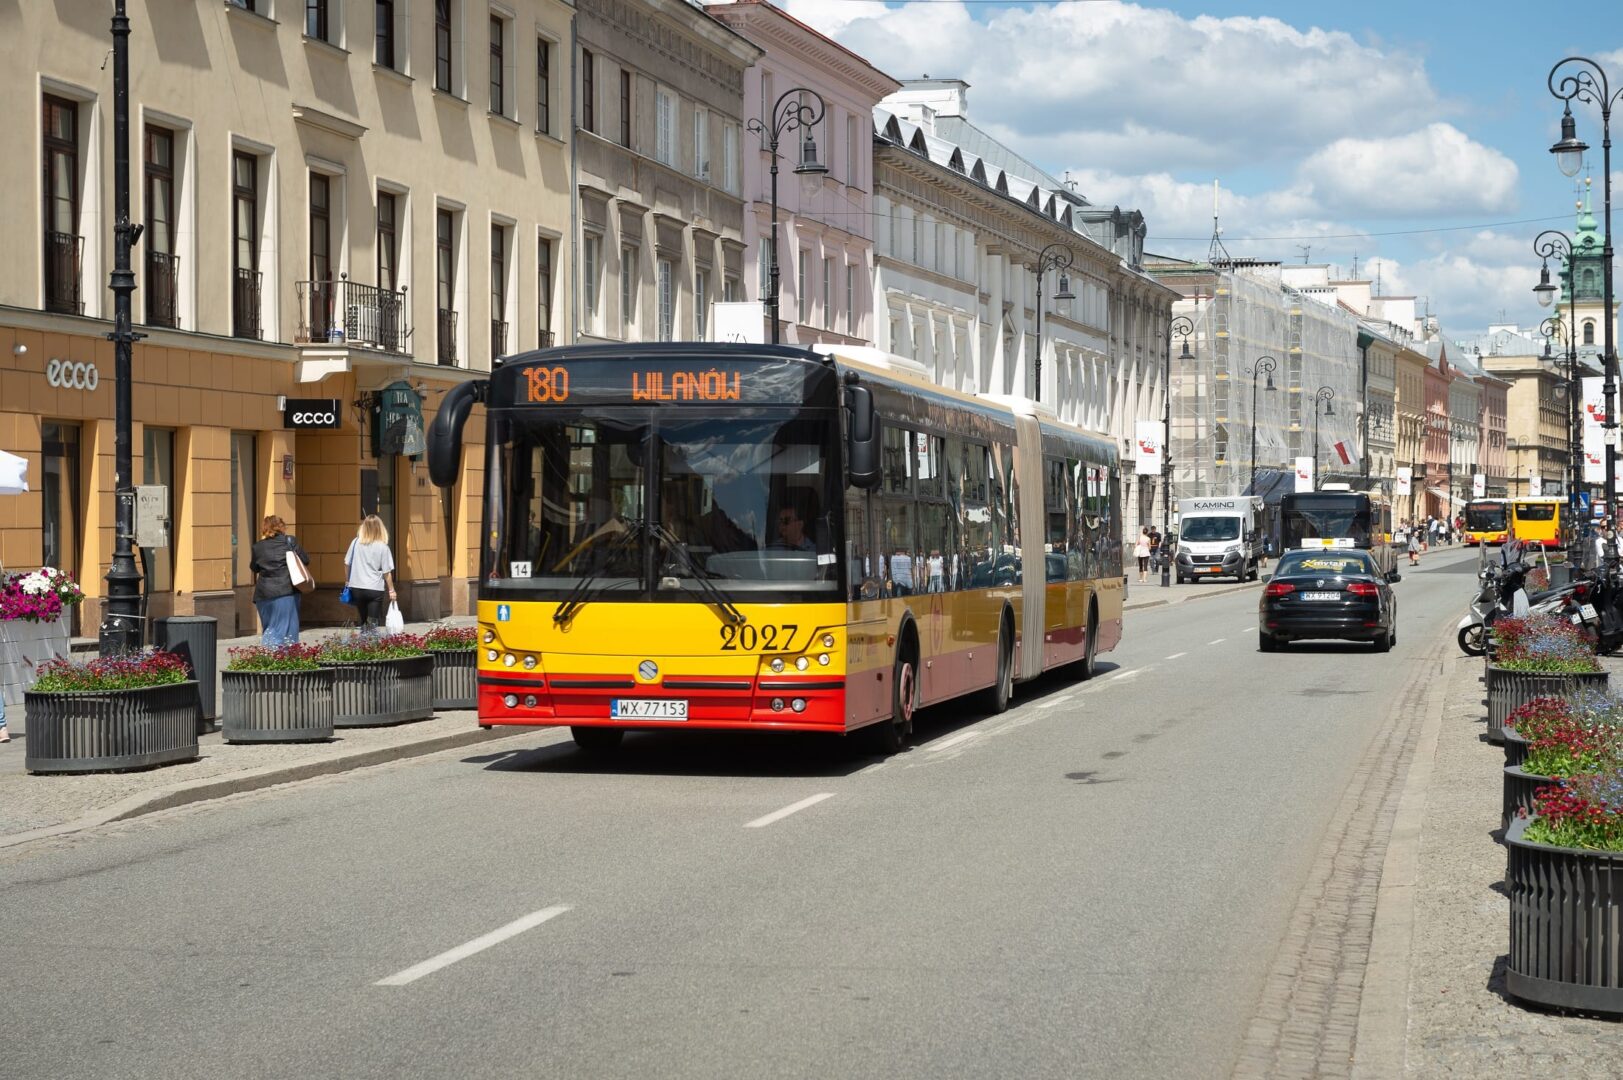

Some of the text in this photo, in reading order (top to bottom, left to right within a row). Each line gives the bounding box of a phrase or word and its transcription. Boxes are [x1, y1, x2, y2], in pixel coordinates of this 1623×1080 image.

[47, 359, 98, 391] ecco
[522, 366, 741, 402] 180 WILANÓW
[292, 412, 335, 424] ecco
[1194, 501, 1235, 510] KAMINO
[514, 563, 528, 577] 14
[719, 624, 798, 651] 2027
[620, 701, 639, 715] WX
[644, 702, 686, 716] 77153
